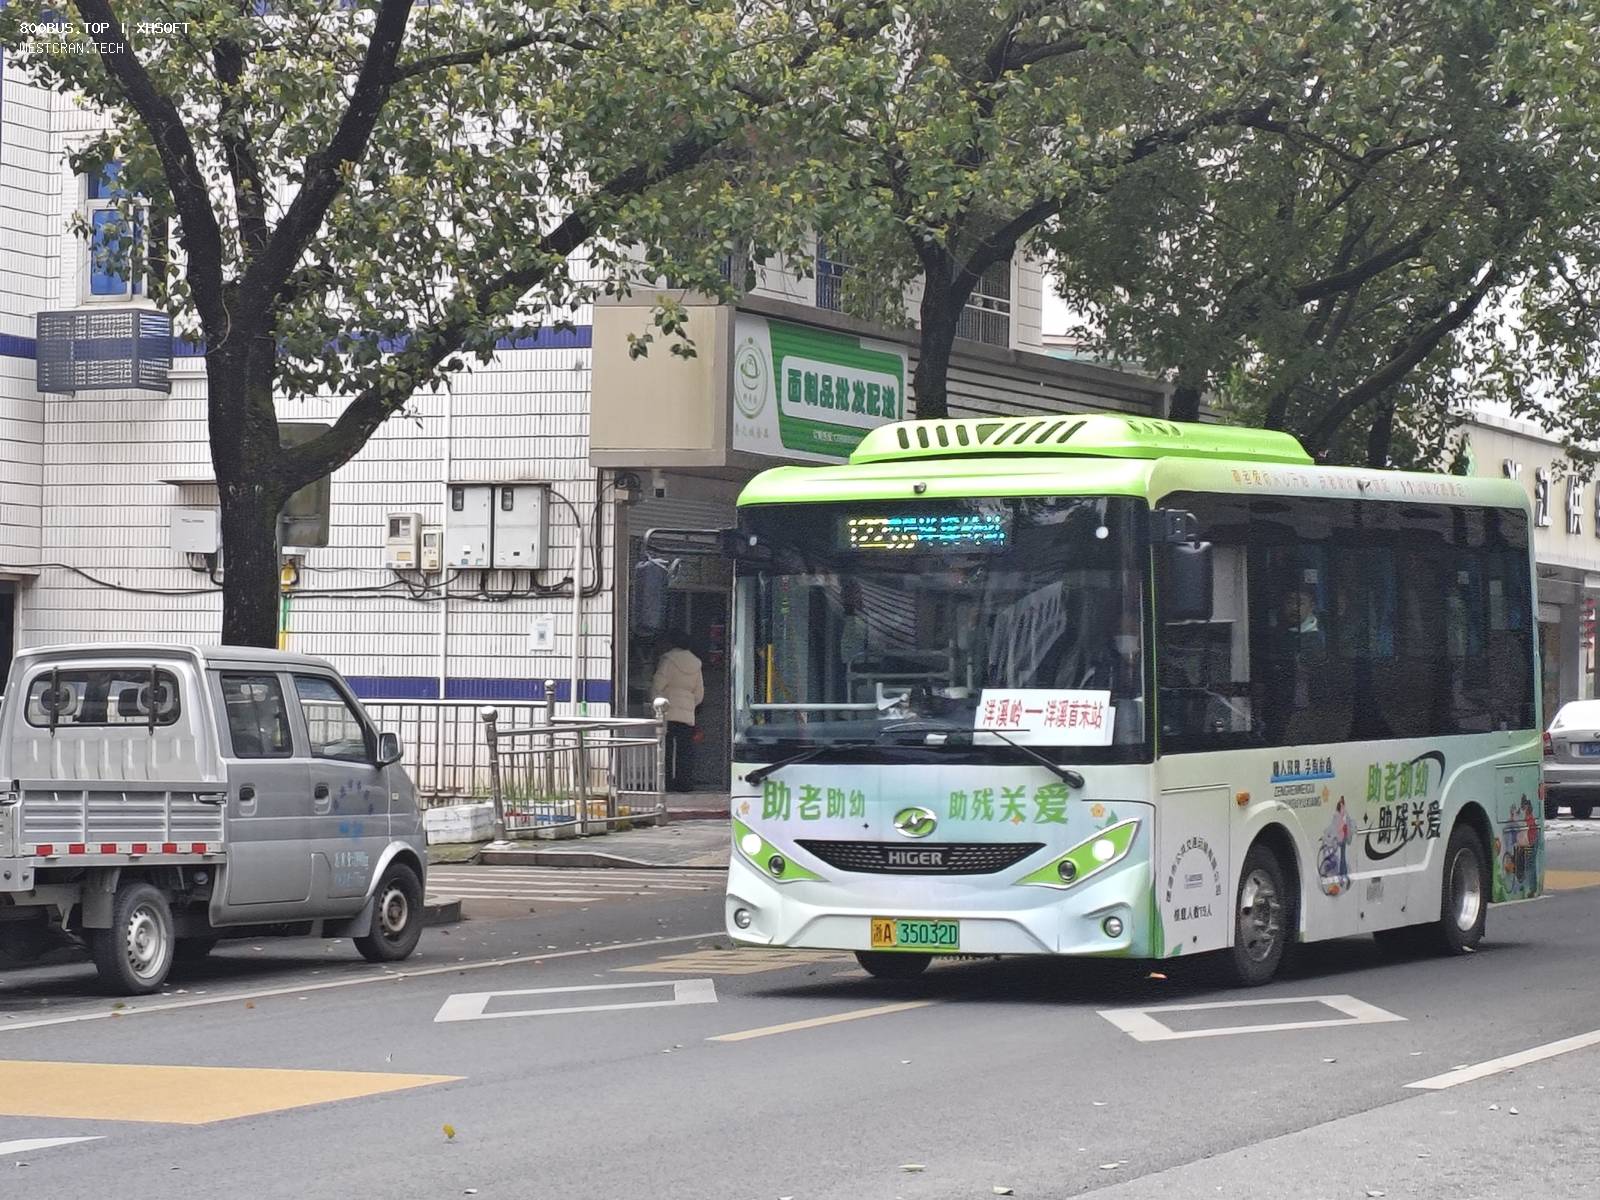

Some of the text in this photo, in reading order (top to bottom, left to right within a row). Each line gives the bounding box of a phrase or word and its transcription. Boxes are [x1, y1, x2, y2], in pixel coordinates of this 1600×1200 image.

[762, 780, 865, 821] 助老助幼
[1367, 761, 1429, 801] 助老助幼
[949, 782, 1069, 824] 助残关爱
[1378, 800, 1441, 843] 助残关爱
[888, 851, 943, 865] HIGER
